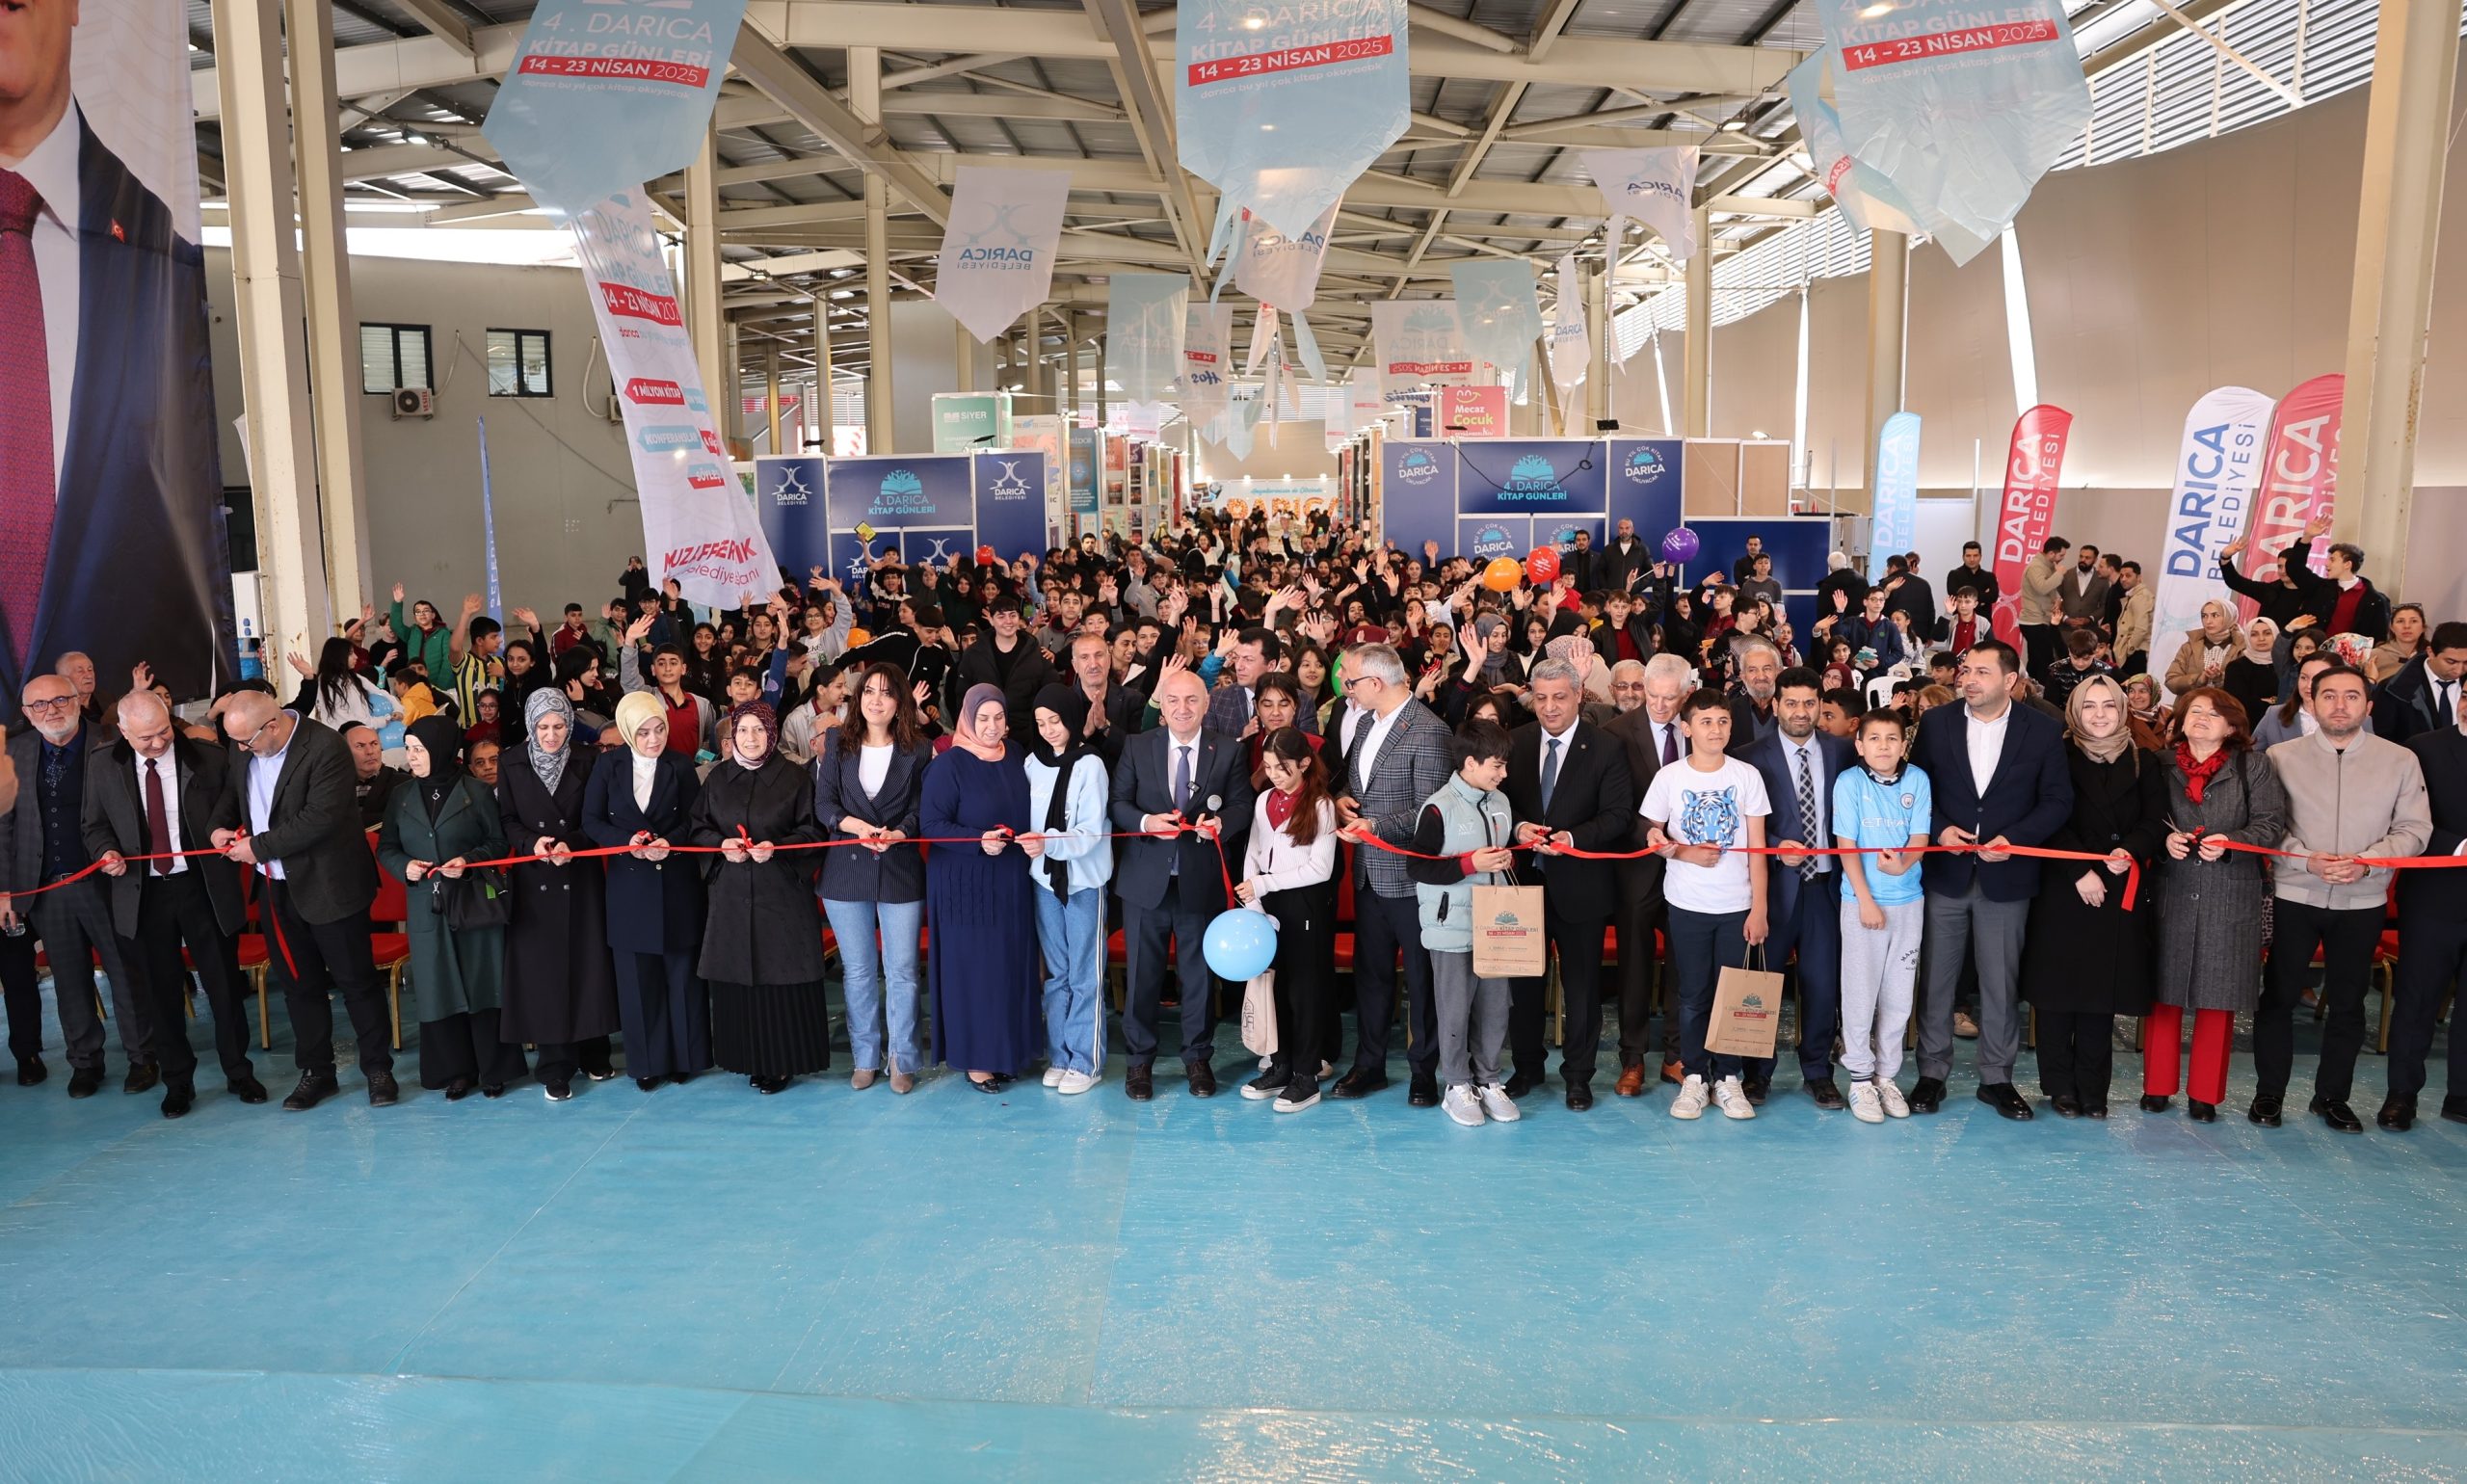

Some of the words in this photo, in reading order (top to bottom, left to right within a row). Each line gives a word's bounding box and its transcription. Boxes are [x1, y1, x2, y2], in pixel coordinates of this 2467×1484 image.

[1248, 0, 1386, 27] DARICA
[1842, 19, 1920, 44] KİTAP
[1929, 6, 2051, 33] GÜNLERİ
[586, 13, 713, 44] DARICA
[1191, 39, 1265, 61] KİTAP
[1271, 18, 1392, 48] GÜNLERİ
[528, 37, 598, 56] KİTAP
[600, 40, 713, 69] GÜNLERİ
[1854, 48, 1877, 64] 14
[1897, 41, 1923, 57] 23
[1926, 33, 1994, 52] NİSAN
[1998, 24, 2048, 42] 2025
[528, 58, 547, 70] 14
[565, 60, 588, 73] 23
[591, 59, 650, 76] NİSAN
[653, 65, 700, 83] 2025
[1198, 64, 1218, 79] 14
[1239, 58, 1261, 72] 23
[1267, 47, 1331, 68] NİSAN
[1337, 40, 1383, 59] 2025
[1960, 56, 1991, 69] kitap
[1238, 82, 1253, 92] bu
[1293, 71, 1324, 84] kitap
[602, 287, 619, 308] 14
[658, 300, 680, 321] 202
[1455, 405, 1485, 413] Mecaz
[1398, 465, 1439, 478] DARICA
[1625, 464, 1665, 477] DARICA
[995, 488, 1026, 496] DARICA
[1498, 490, 1525, 500] KİTAP
[1504, 482, 1513, 490] 4.
[1517, 481, 1560, 490] DARICA
[1873, 435, 1903, 547] DARICA
[1897, 435, 1914, 549] BELEDİYESİ
[868, 506, 894, 515] KİTAP
[895, 504, 936, 515] GÜNLERİ
[874, 496, 884, 505] 4.
[887, 495, 929, 506] DARICA
[2000, 434, 2042, 564] DARICA
[2166, 423, 2231, 577] DARICA
[1473, 542, 1514, 554] DARICA
